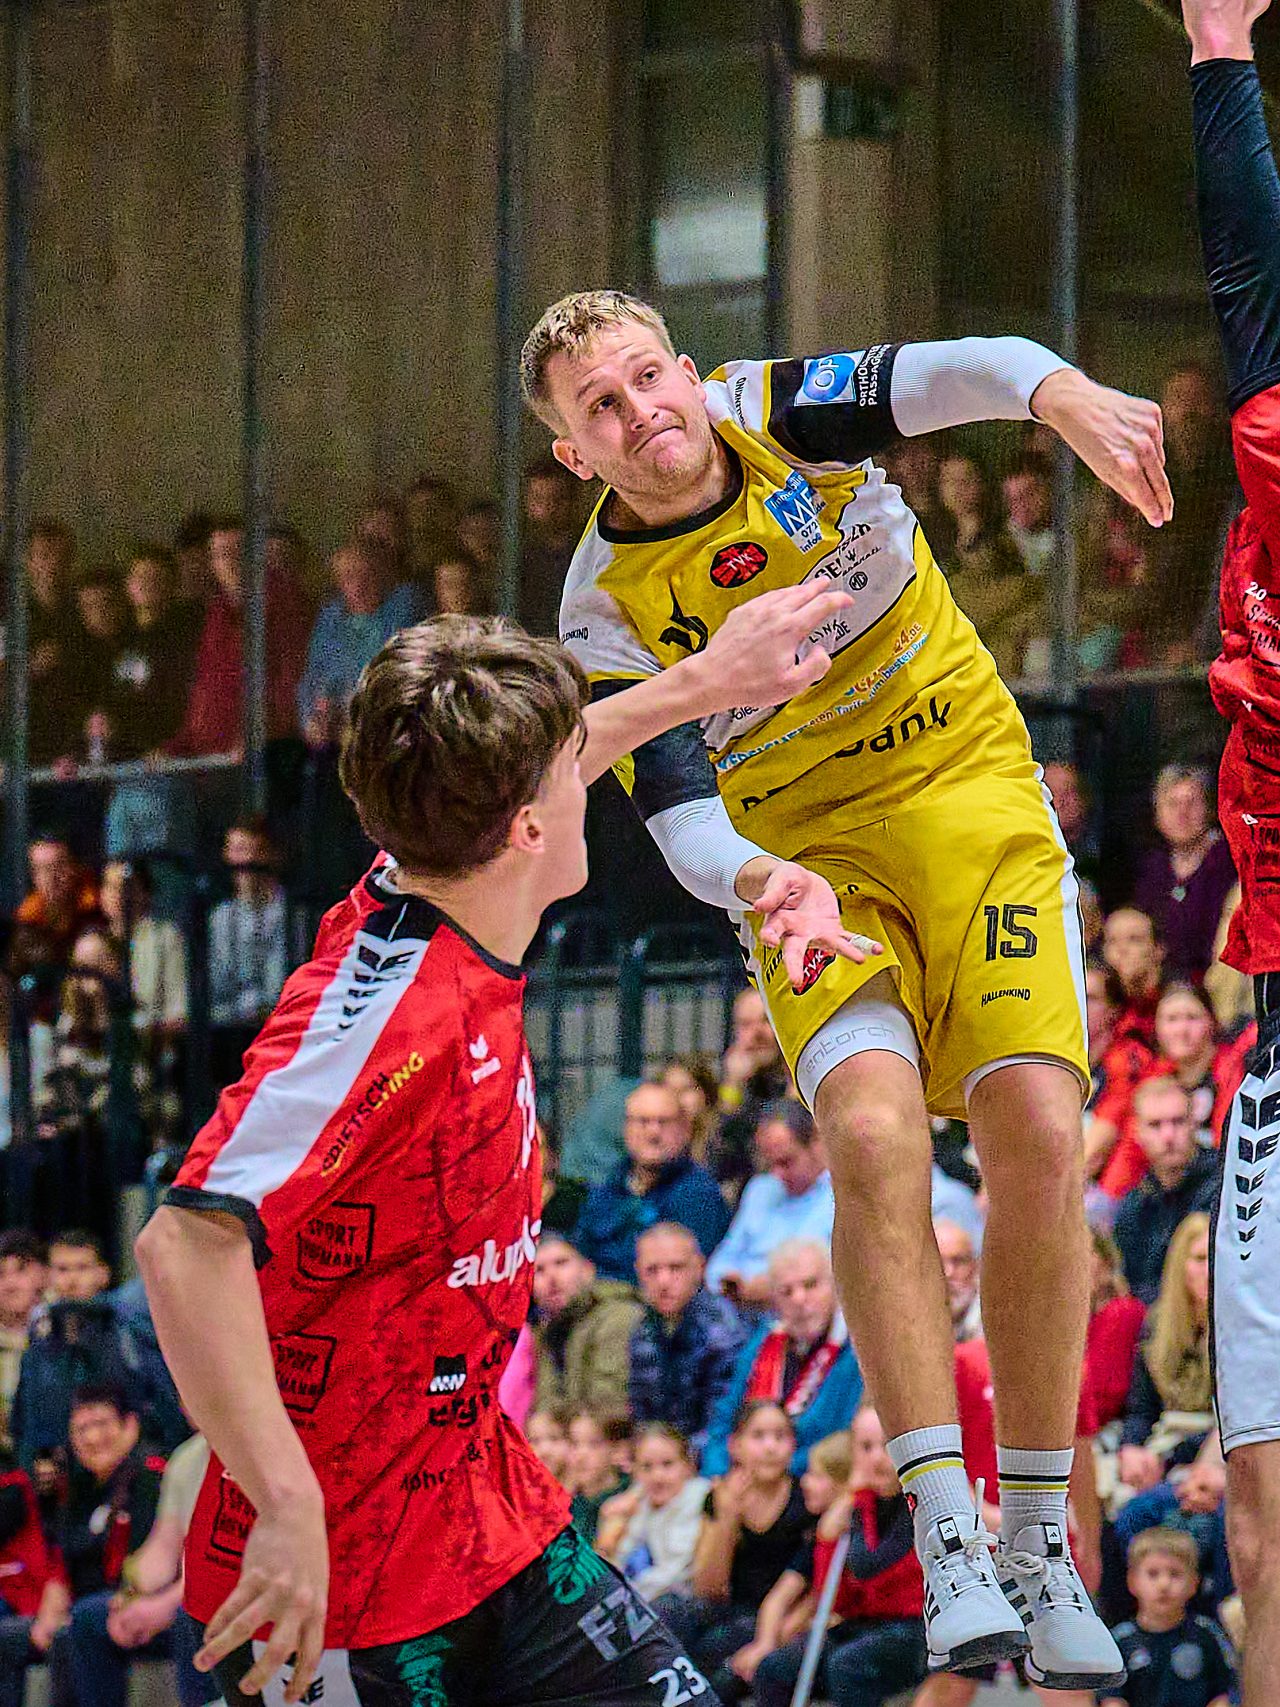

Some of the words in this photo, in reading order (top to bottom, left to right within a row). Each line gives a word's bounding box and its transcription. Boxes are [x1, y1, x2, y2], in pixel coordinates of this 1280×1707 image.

[727, 552, 754, 571] TVK
[882, 650, 914, 680] besten
[983, 903, 1038, 961] 15
[804, 950, 825, 977] TVK
[981, 988, 1031, 1008] HALLENKIND
[648, 1656, 708, 1707] 23
